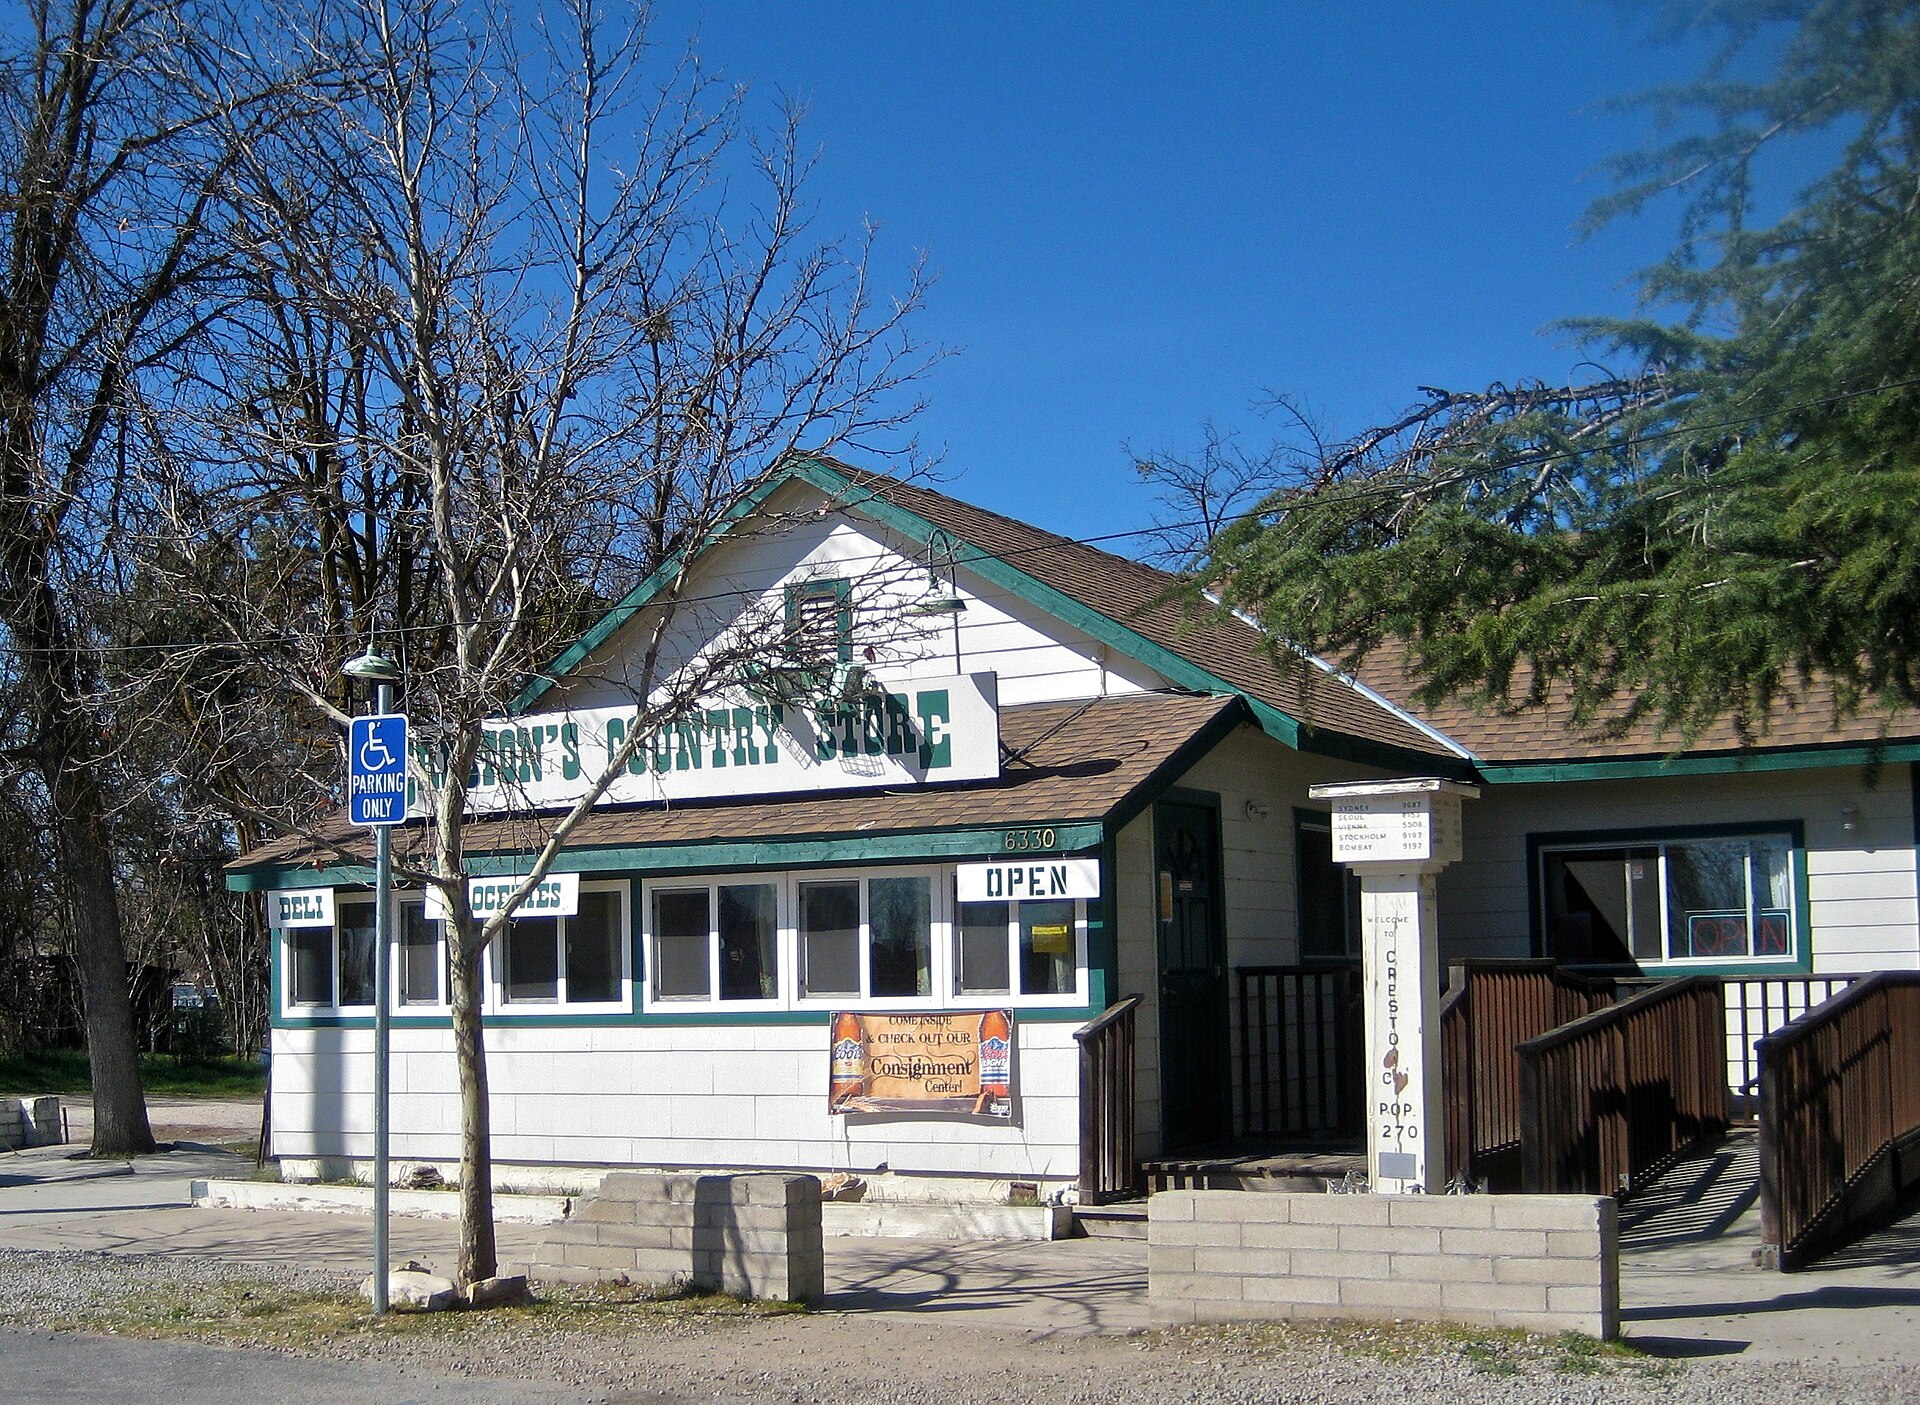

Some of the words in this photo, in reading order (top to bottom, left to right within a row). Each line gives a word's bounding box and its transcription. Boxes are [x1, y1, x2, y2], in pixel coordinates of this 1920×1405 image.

[606, 705, 783, 775] COUNTRY
[815, 689, 951, 769] STORE
[353, 772, 403, 795] PARKING
[363, 798, 392, 819] ONLY
[1338, 804, 1369, 812] SYDNEY
[1005, 828, 1056, 850] 6330
[1339, 833, 1387, 842] STOCKHOLM
[987, 865, 1067, 896] OPEN
[279, 895, 323, 920] DELI
[1694, 919, 1786, 954] OPN
[1386, 950, 1399, 1047] CRESTO
[888, 1015, 918, 1026] COME
[919, 1014, 952, 1028] INSIDE
[866, 1034, 875, 1043] &
[878, 1033, 916, 1044] CHECK
[919, 1032, 943, 1046] OUT
[946, 1032, 971, 1044] OUR
[870, 1057, 972, 1080] Consignment
[983, 1059, 1006, 1067] LIGHT
[924, 1079, 963, 1094] Center!
[1382, 1125, 1418, 1139] 270
